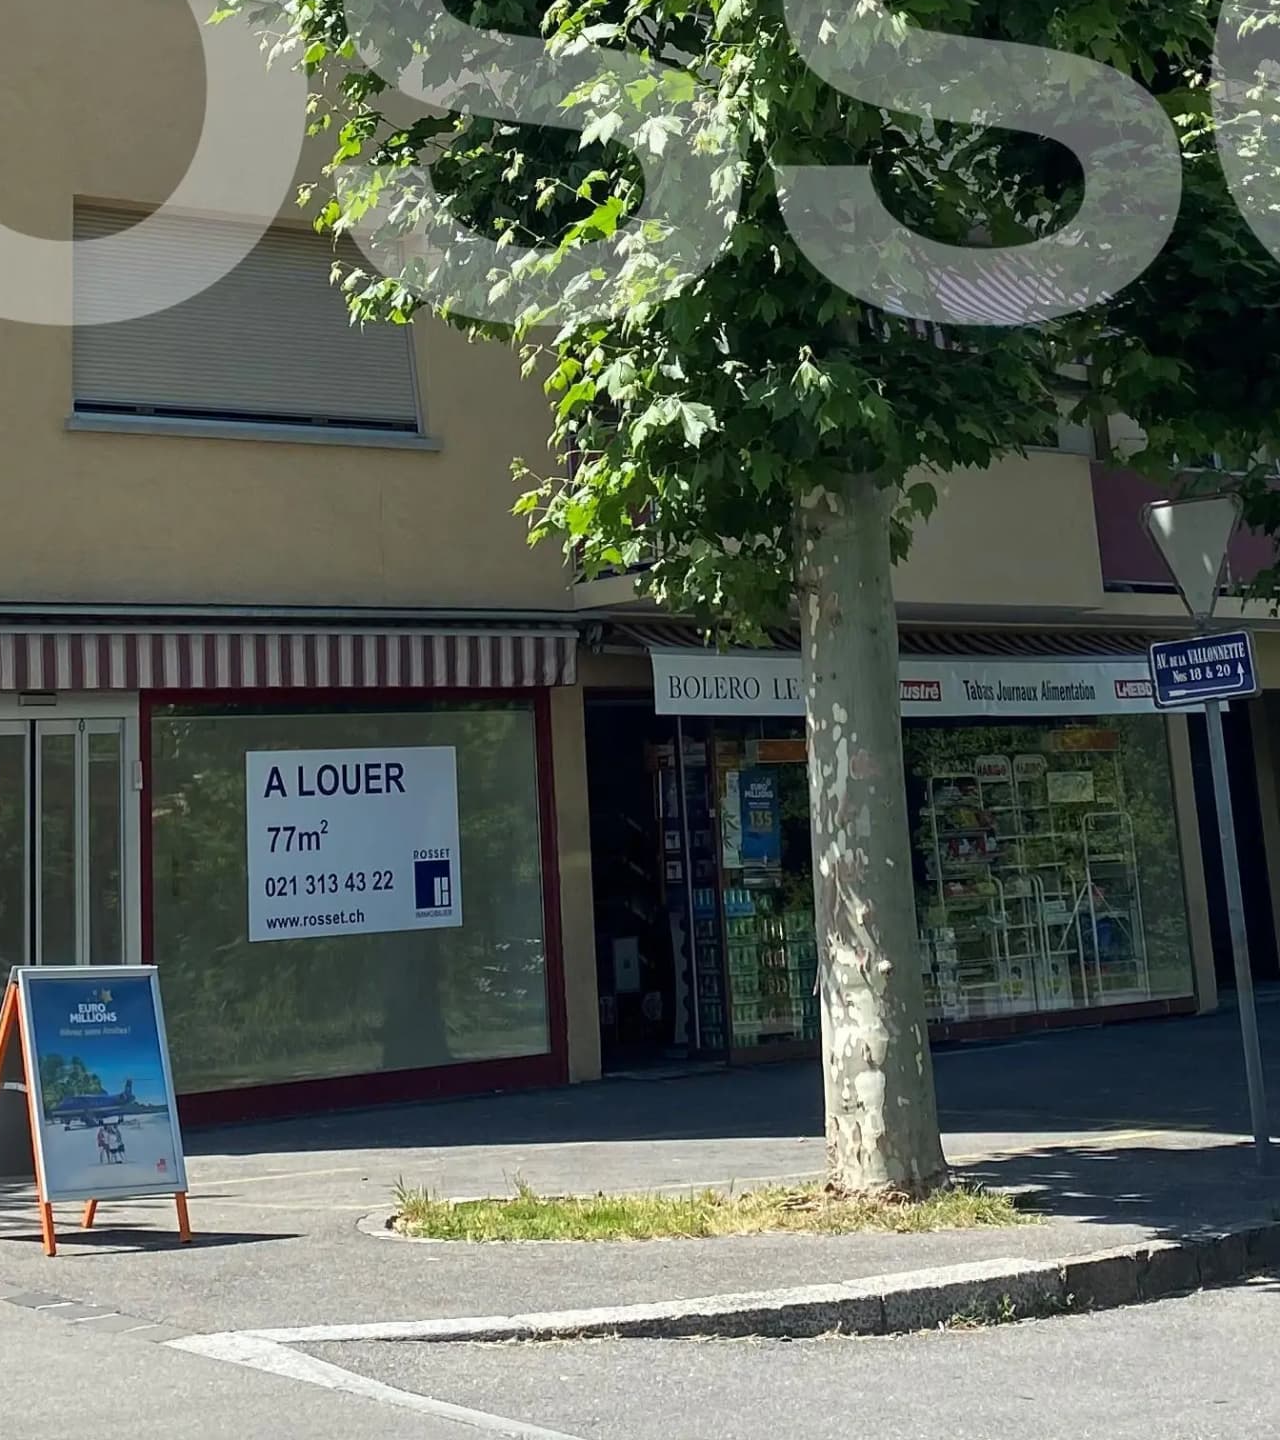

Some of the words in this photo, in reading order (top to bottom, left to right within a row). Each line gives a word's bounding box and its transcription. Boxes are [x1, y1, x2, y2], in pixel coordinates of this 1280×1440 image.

[1157, 653, 1169, 670] AV.
[1187, 642, 1246, 665] VALLONNETTE
[1216, 664, 1231, 677] 20
[668, 675, 760, 700] BOLERO
[899, 682, 940, 700] lustré
[996, 680, 1038, 702] Journaux
[1041, 679, 1096, 700] Alimentation
[1116, 681, 1153, 697] L'HEBD
[264, 766, 288, 798] A
[298, 762, 406, 797] LOUER
[413, 848, 450, 859] ROSSET
[265, 876, 297, 897] 021
[305, 873, 338, 895] 313
[345, 872, 366, 892] 43
[372, 870, 394, 890] 22
[266, 909, 365, 929] www.rosset.ch
[69, 1012, 117, 1023] MILLIONS
[78, 1003, 106, 1013] EURO
